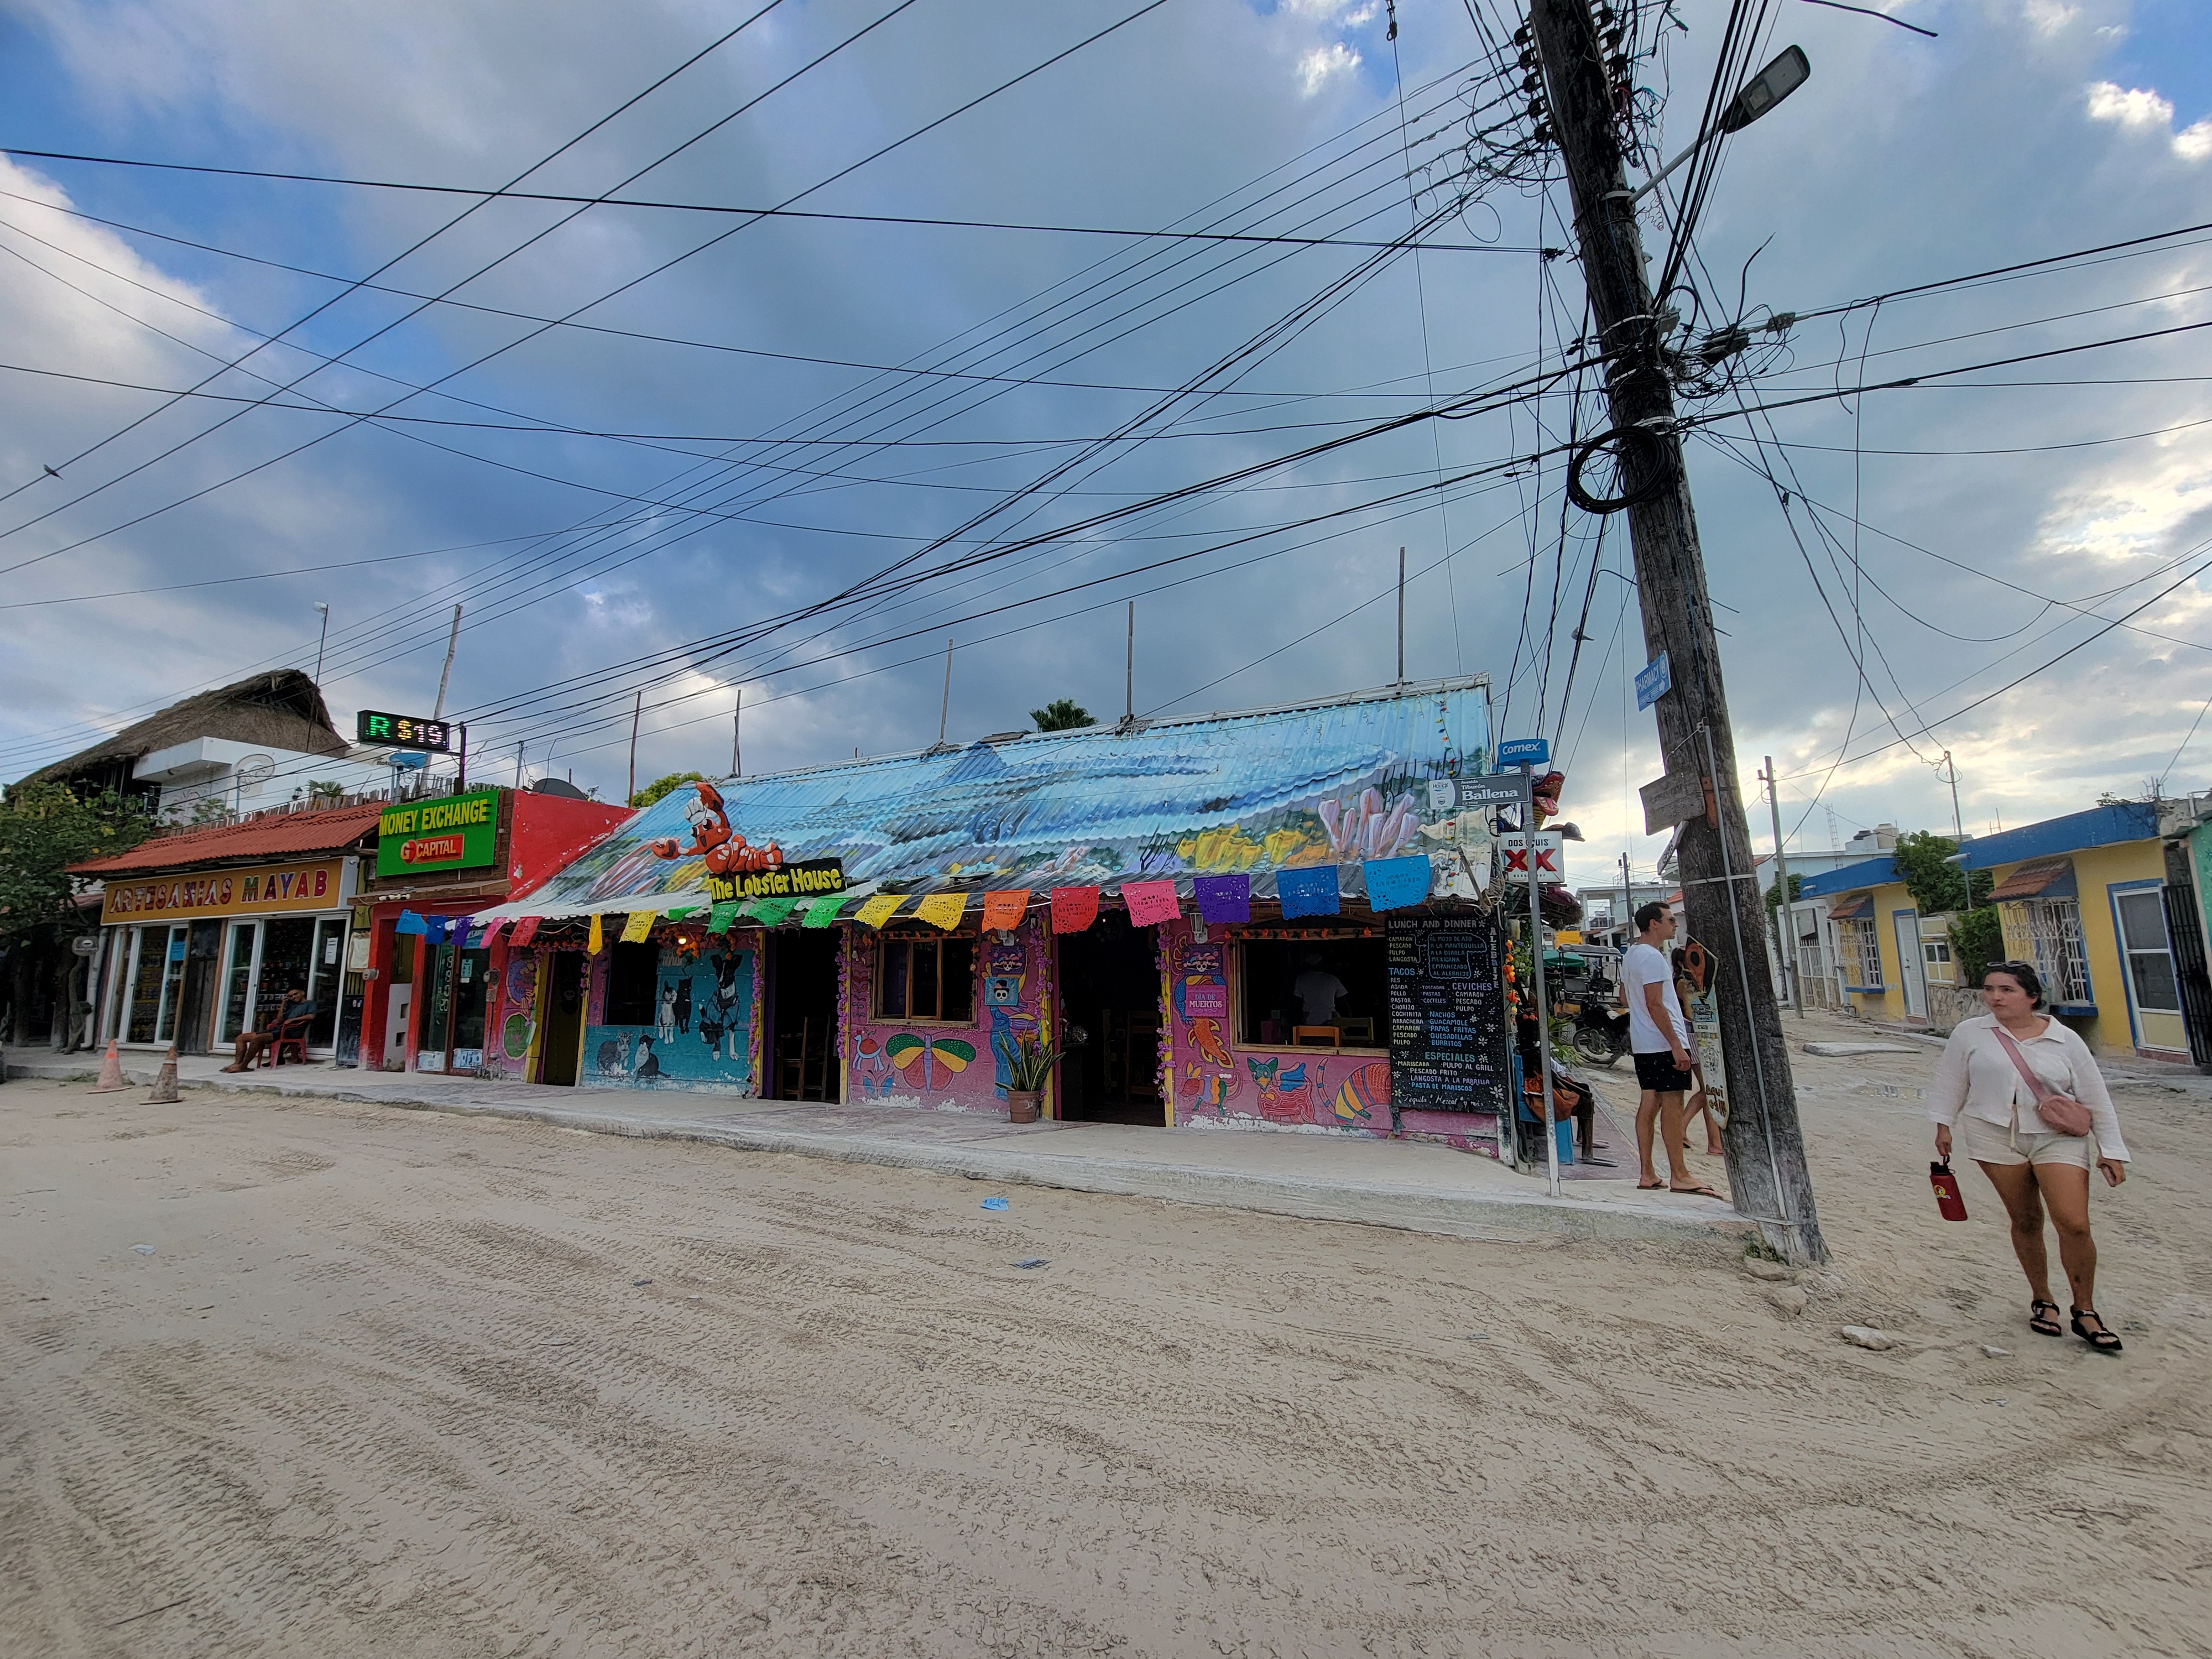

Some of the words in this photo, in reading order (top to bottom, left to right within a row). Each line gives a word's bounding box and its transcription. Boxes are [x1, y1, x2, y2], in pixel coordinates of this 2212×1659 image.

[1636, 664, 1659, 693] PHARMACY
[1461, 789, 1519, 801] Ballena
[379, 810, 418, 836] MONEY
[421, 799, 488, 830] EXCHANGE
[416, 839, 456, 857] CAPITAL
[109, 878, 232, 913] ARTESANIAS
[241, 869, 328, 904] MAYAB
[708, 877, 733, 900] The
[790, 868, 842, 893] House
[1389, 920, 1417, 928] LUNCH
[1444, 920, 1477, 928] DINNER
[1489, 927, 1499, 988] ALEBRIJE
[1452, 982, 1493, 991] CEVICHES
[1425, 1052, 1475, 1062] ESPECIALES
[1463, 1078, 1490, 1086] PARRILLA
